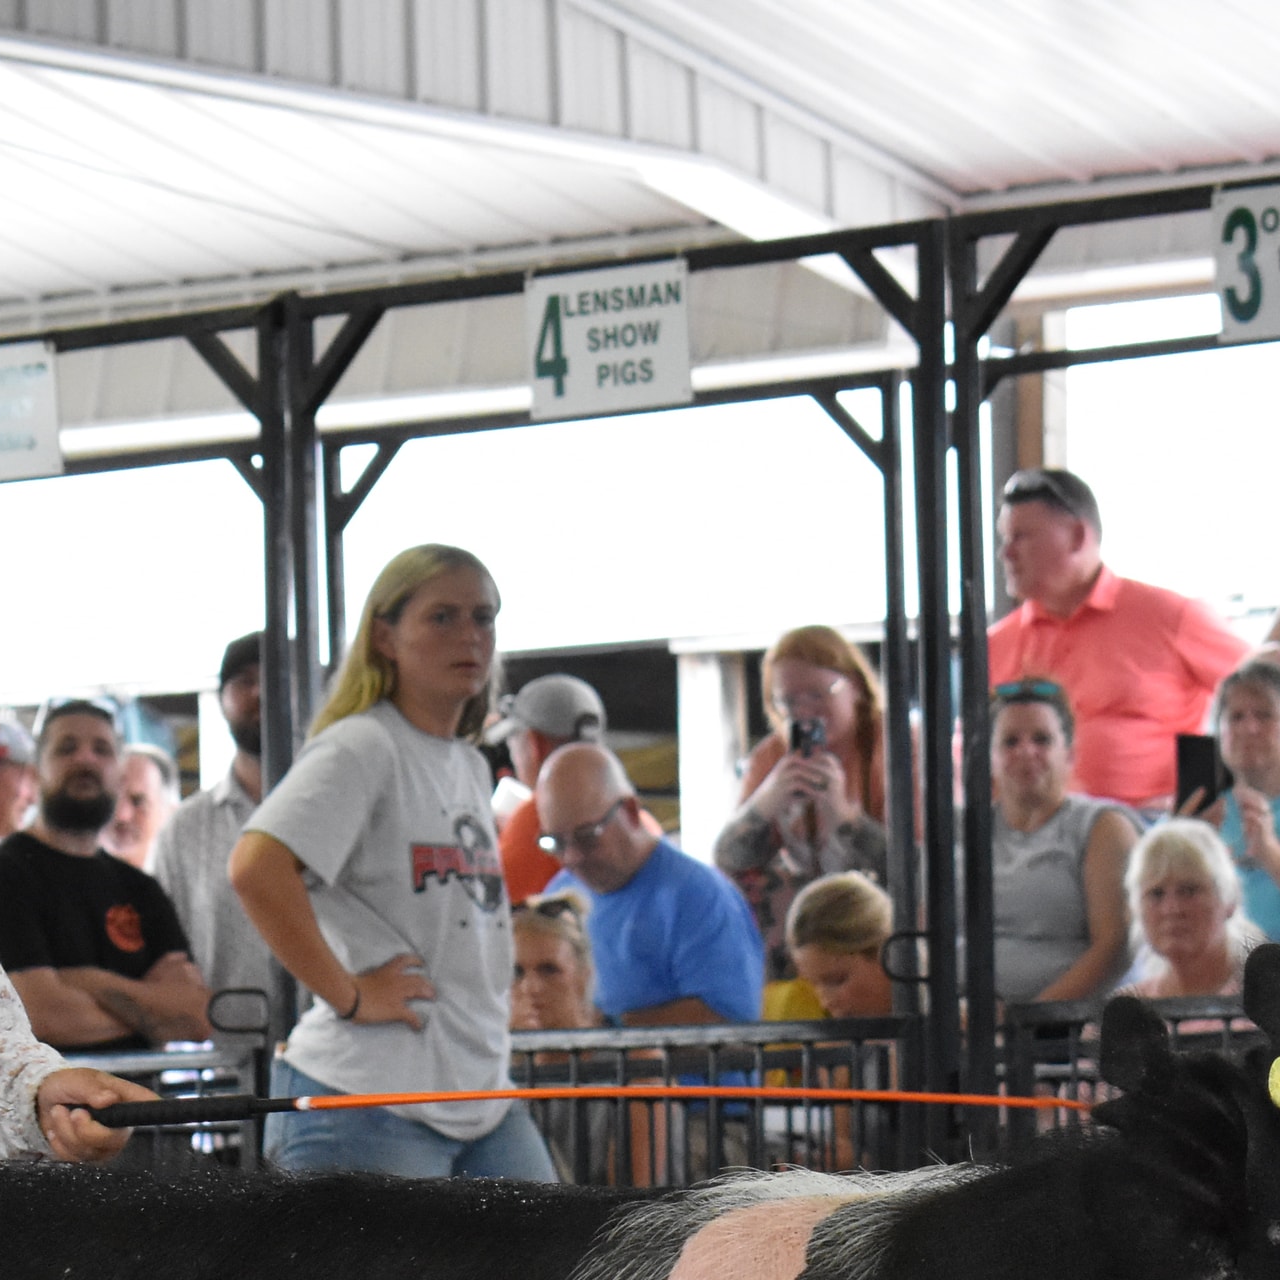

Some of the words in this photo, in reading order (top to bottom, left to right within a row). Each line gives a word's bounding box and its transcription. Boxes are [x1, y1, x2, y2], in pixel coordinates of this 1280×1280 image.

[1222, 206, 1261, 324] 3
[563, 280, 681, 317] LENSMAN
[535, 294, 568, 398] 4
[587, 319, 660, 352] SHOW
[596, 358, 654, 388] PIGS
